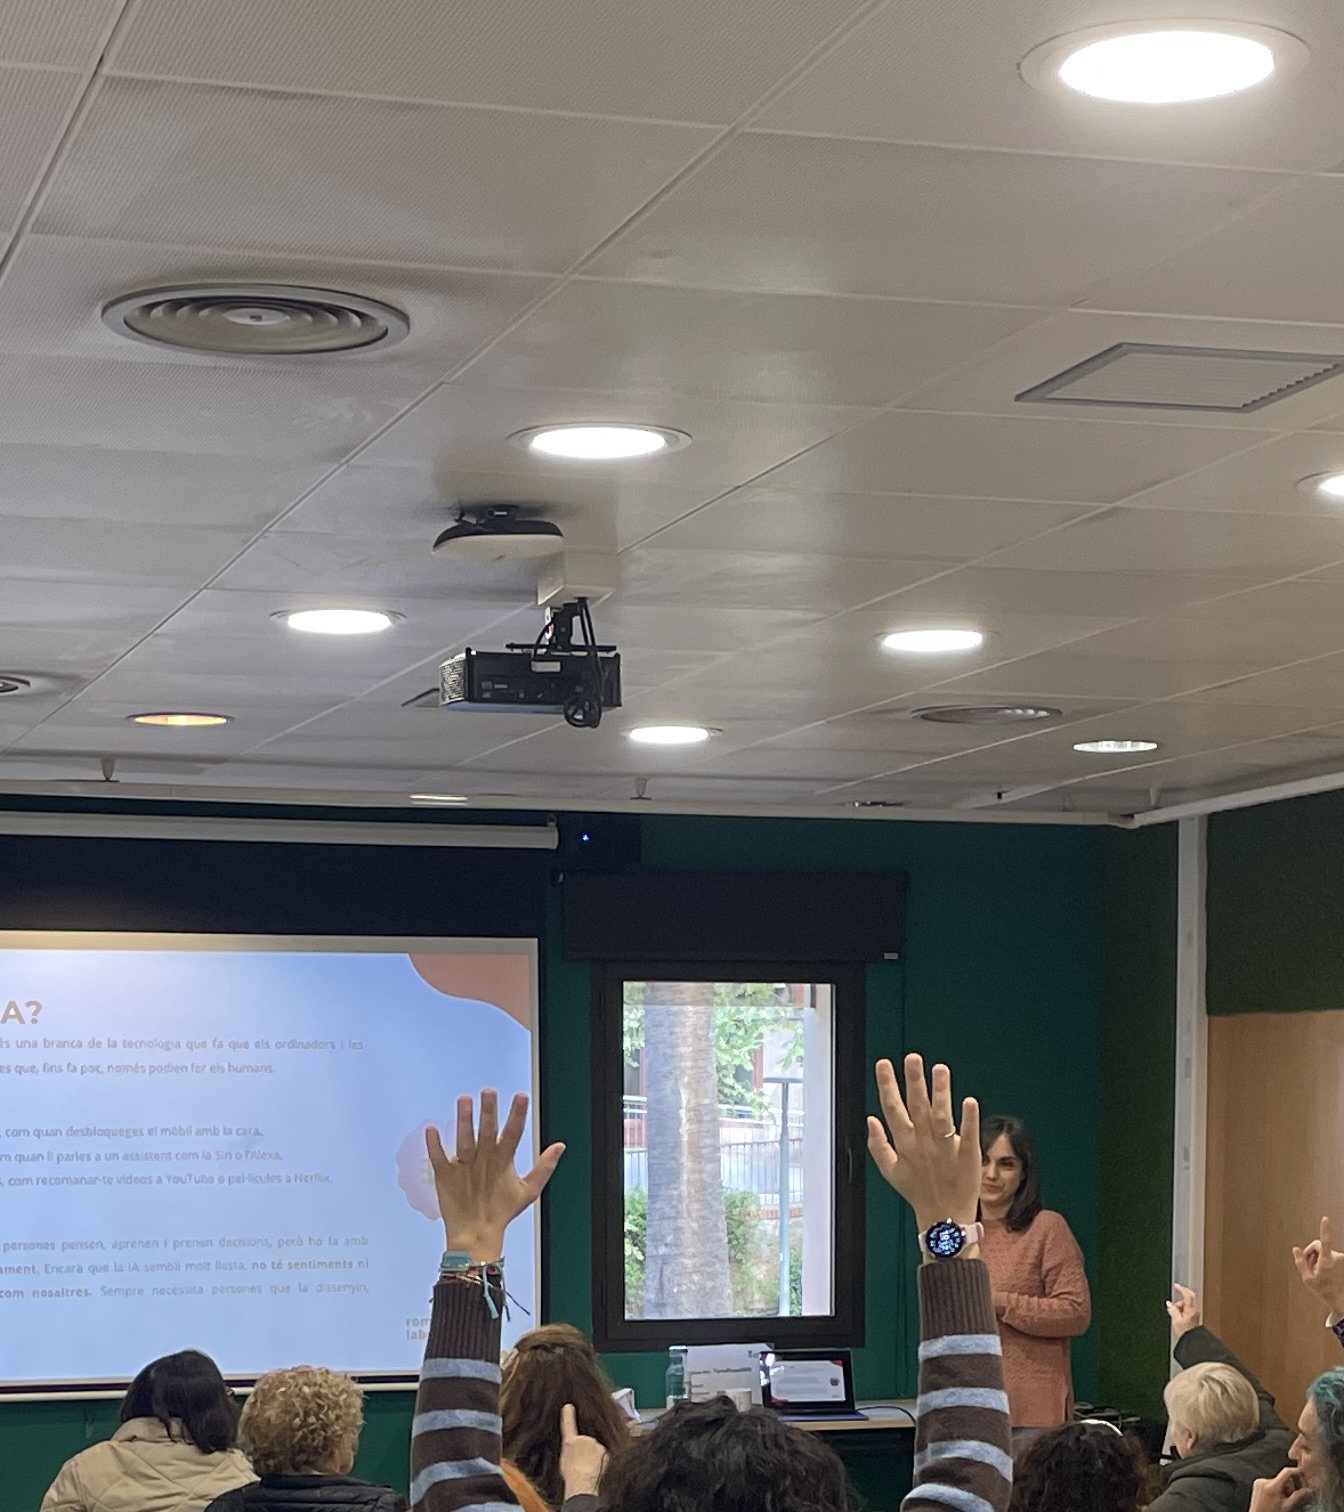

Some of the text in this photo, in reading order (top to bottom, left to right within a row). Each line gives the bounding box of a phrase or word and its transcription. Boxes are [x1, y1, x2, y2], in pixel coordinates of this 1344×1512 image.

[16, 1040, 38, 1048] una
[43, 1038, 83, 1048] branca
[88, 1038, 102, 1048] de
[108, 1038, 117, 1049] la
[123, 1039, 180, 1051] tecnologia
[186, 1041, 207, 1051] que
[213, 1038, 223, 1049] fa
[228, 1041, 249, 1051] que
[255, 1039, 270, 1049] els
[275, 1039, 335, 1050] ordinadors
[348, 1039, 363, 1050] les
[15, 1065, 38, 1076] que,
[43, 1062, 63, 1073] fins
[67, 1062, 77, 1073] fa
[81, 1065, 104, 1076] poc,
[108, 1062, 145, 1072] només
[149, 1063, 188, 1075] podien
[191, 1062, 206, 1072] fer
[210, 1063, 225, 1072] els
[228, 1063, 275, 1073] humans.
[6, 1129, 30, 1137] com
[34, 1129, 63, 1139] quan
[67, 1127, 144, 1139] desbloqueges
[147, 1127, 157, 1136] el
[161, 1126, 192, 1136] mòbil
[195, 1127, 220, 1136] amb
[223, 1127, 233, 1136] la
[236, 1128, 264, 1137] cara.
[14, 1153, 44, 1164] quan
[47, 1152, 53, 1161] li
[57, 1151, 91, 1164] parles
[105, 1152, 119, 1161] un
[122, 1151, 172, 1161] assistent
[175, 1152, 199, 1160] com
[203, 1150, 212, 1160] la
[215, 1150, 232, 1160] Siri
[8, 1177, 33, 1186] com
[36, 1175, 113, 1186] recomanar-te
[117, 1174, 153, 1184] vídeos
[166, 1174, 214, 1184] YouTube
[3, 1241, 55, 1253] persones
[62, 1240, 106, 1253] pensen,
[112, 1239, 159, 1250] aprenen
[173, 1239, 213, 1250] prenen
[219, 1237, 272, 1249] decisions,
[278, 1236, 303, 1249] però
[308, 1236, 322, 1246] ho
[328, 1236, 338, 1246] fa
[344, 1236, 367, 1246] amb
[44, 1263, 82, 1274] Encara
[87, 1263, 109, 1275] que
[114, 1262, 124, 1272] la
[128, 1262, 139, 1272] IA
[144, 1261, 180, 1272] sembli
[186, 1260, 210, 1271] molt
[252, 1261, 266, 1270] no
[272, 1259, 282, 1269] té
[287, 1259, 352, 1270] sentiments
[358, 1259, 368, 1269] ni
[32, 1287, 92, 1298] nosaltres.
[101, 1286, 144, 1297] Sempre
[152, 1285, 203, 1295] necessita
[212, 1284, 262, 1296] persones
[270, 1284, 290, 1295] que
[298, 1282, 308, 1292] la
[316, 1282, 368, 1294] dissenyin,
